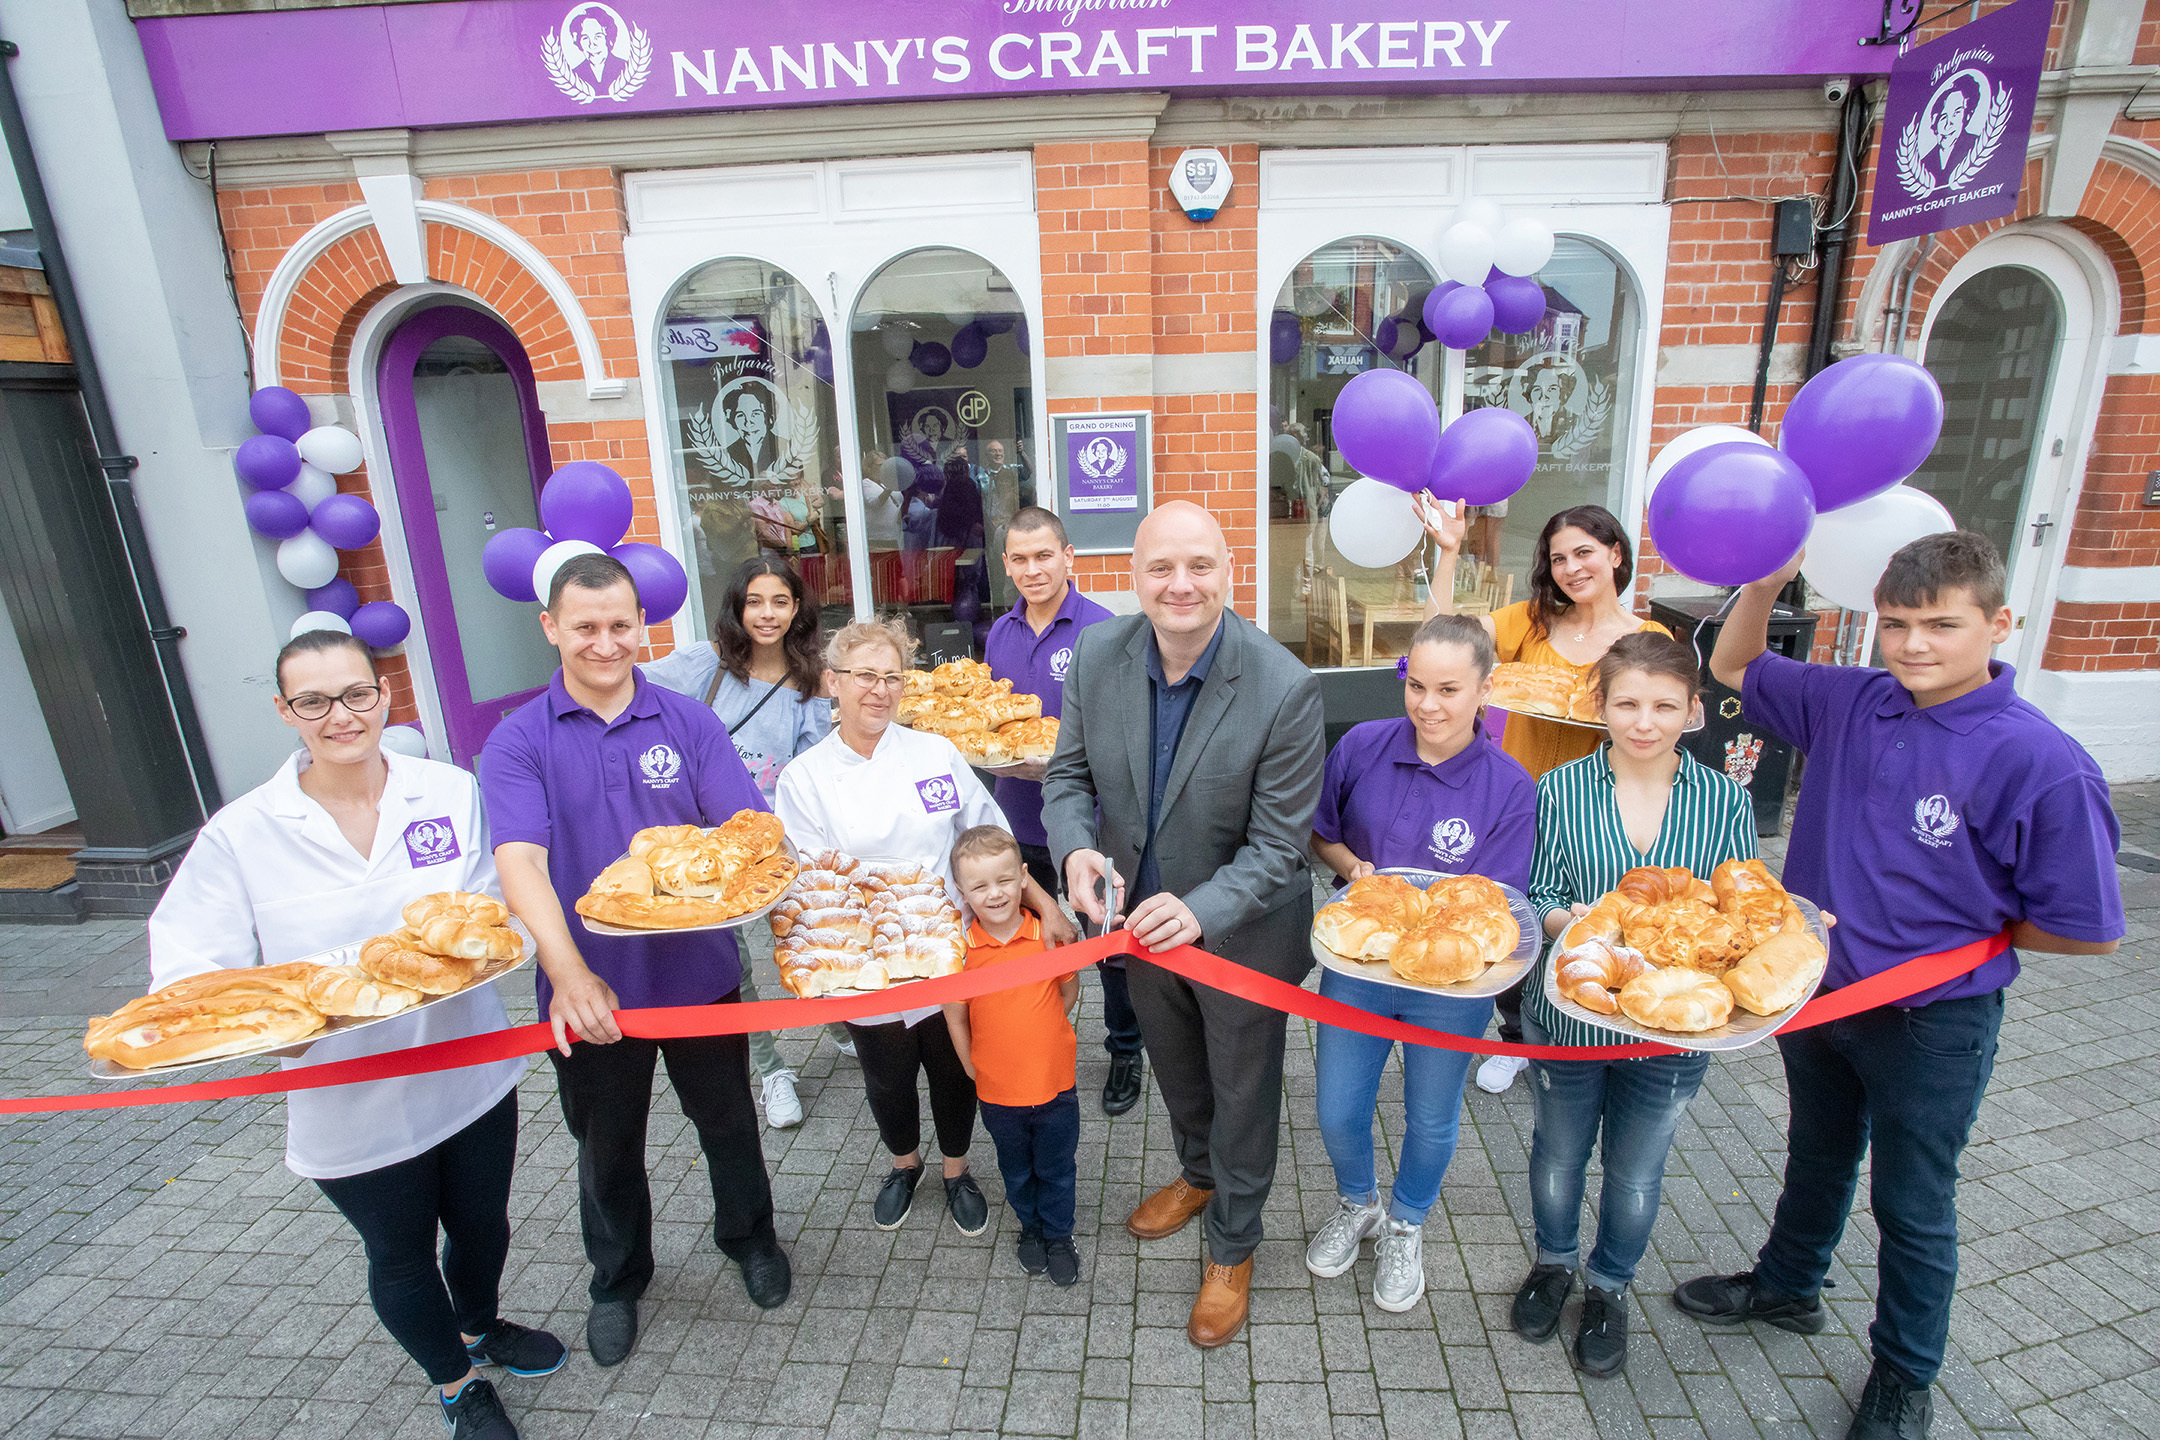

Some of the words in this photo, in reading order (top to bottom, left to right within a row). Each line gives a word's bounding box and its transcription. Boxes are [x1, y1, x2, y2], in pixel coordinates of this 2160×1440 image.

[671, 36, 971, 97] NANNY'S
[989, 25, 1218, 80] CRAFT
[1235, 20, 1511, 72] BAKERY
[1930, 44, 1995, 86] Bulgarian
[1187, 163, 1215, 176] SST
[1881, 203, 1922, 222] NANNY'S
[1923, 195, 1957, 212] CRAFT
[1958, 183, 2004, 203] BAKERY
[1069, 422, 1097, 430] GRAND
[1099, 421, 1134, 429] OPENING
[1534, 463, 1563, 472] RAFT
[1565, 463, 1612, 471] BAKERY
[689, 492, 741, 502] NANNY'S
[743, 489, 782, 500] CRAFT
[784, 486, 830, 498] BAKERY
